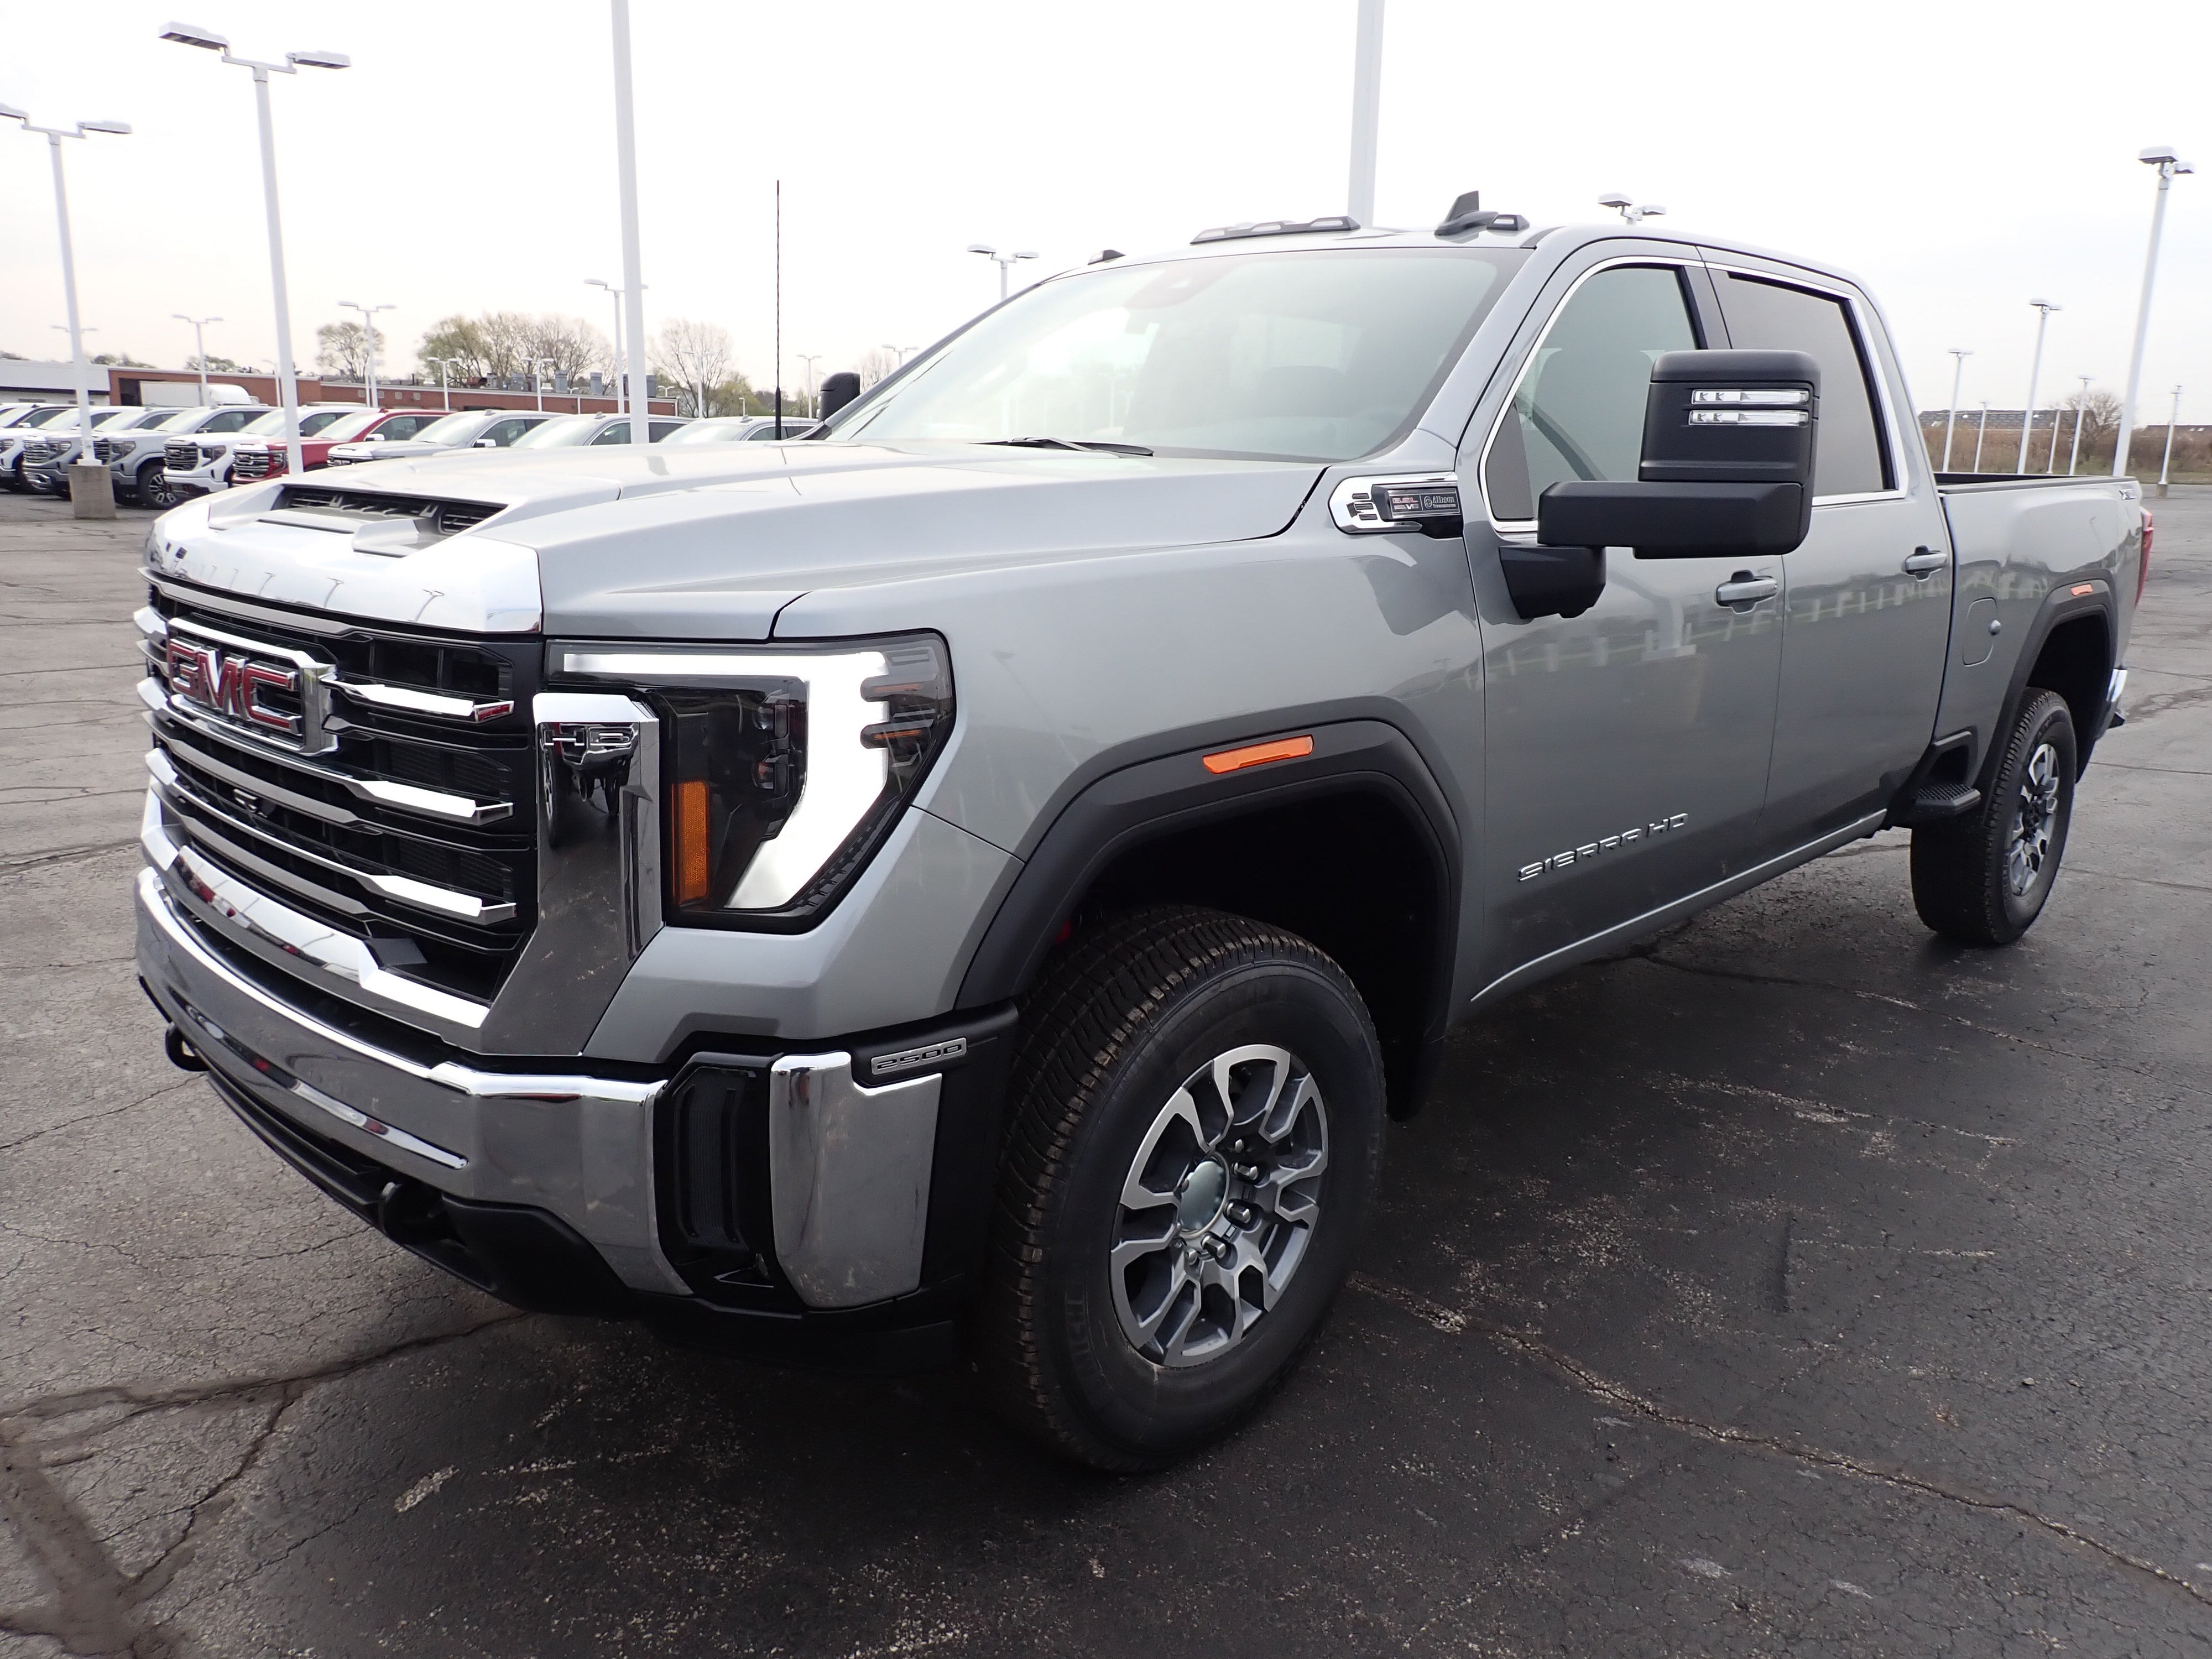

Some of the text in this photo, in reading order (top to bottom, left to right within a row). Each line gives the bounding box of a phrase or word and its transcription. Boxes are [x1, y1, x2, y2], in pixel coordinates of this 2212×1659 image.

[1432, 495, 1455, 504] Allison
[168, 636, 302, 736] GMC
[1517, 812, 1688, 882] SIERRA HD
[877, 1044, 963, 1071] 2500
